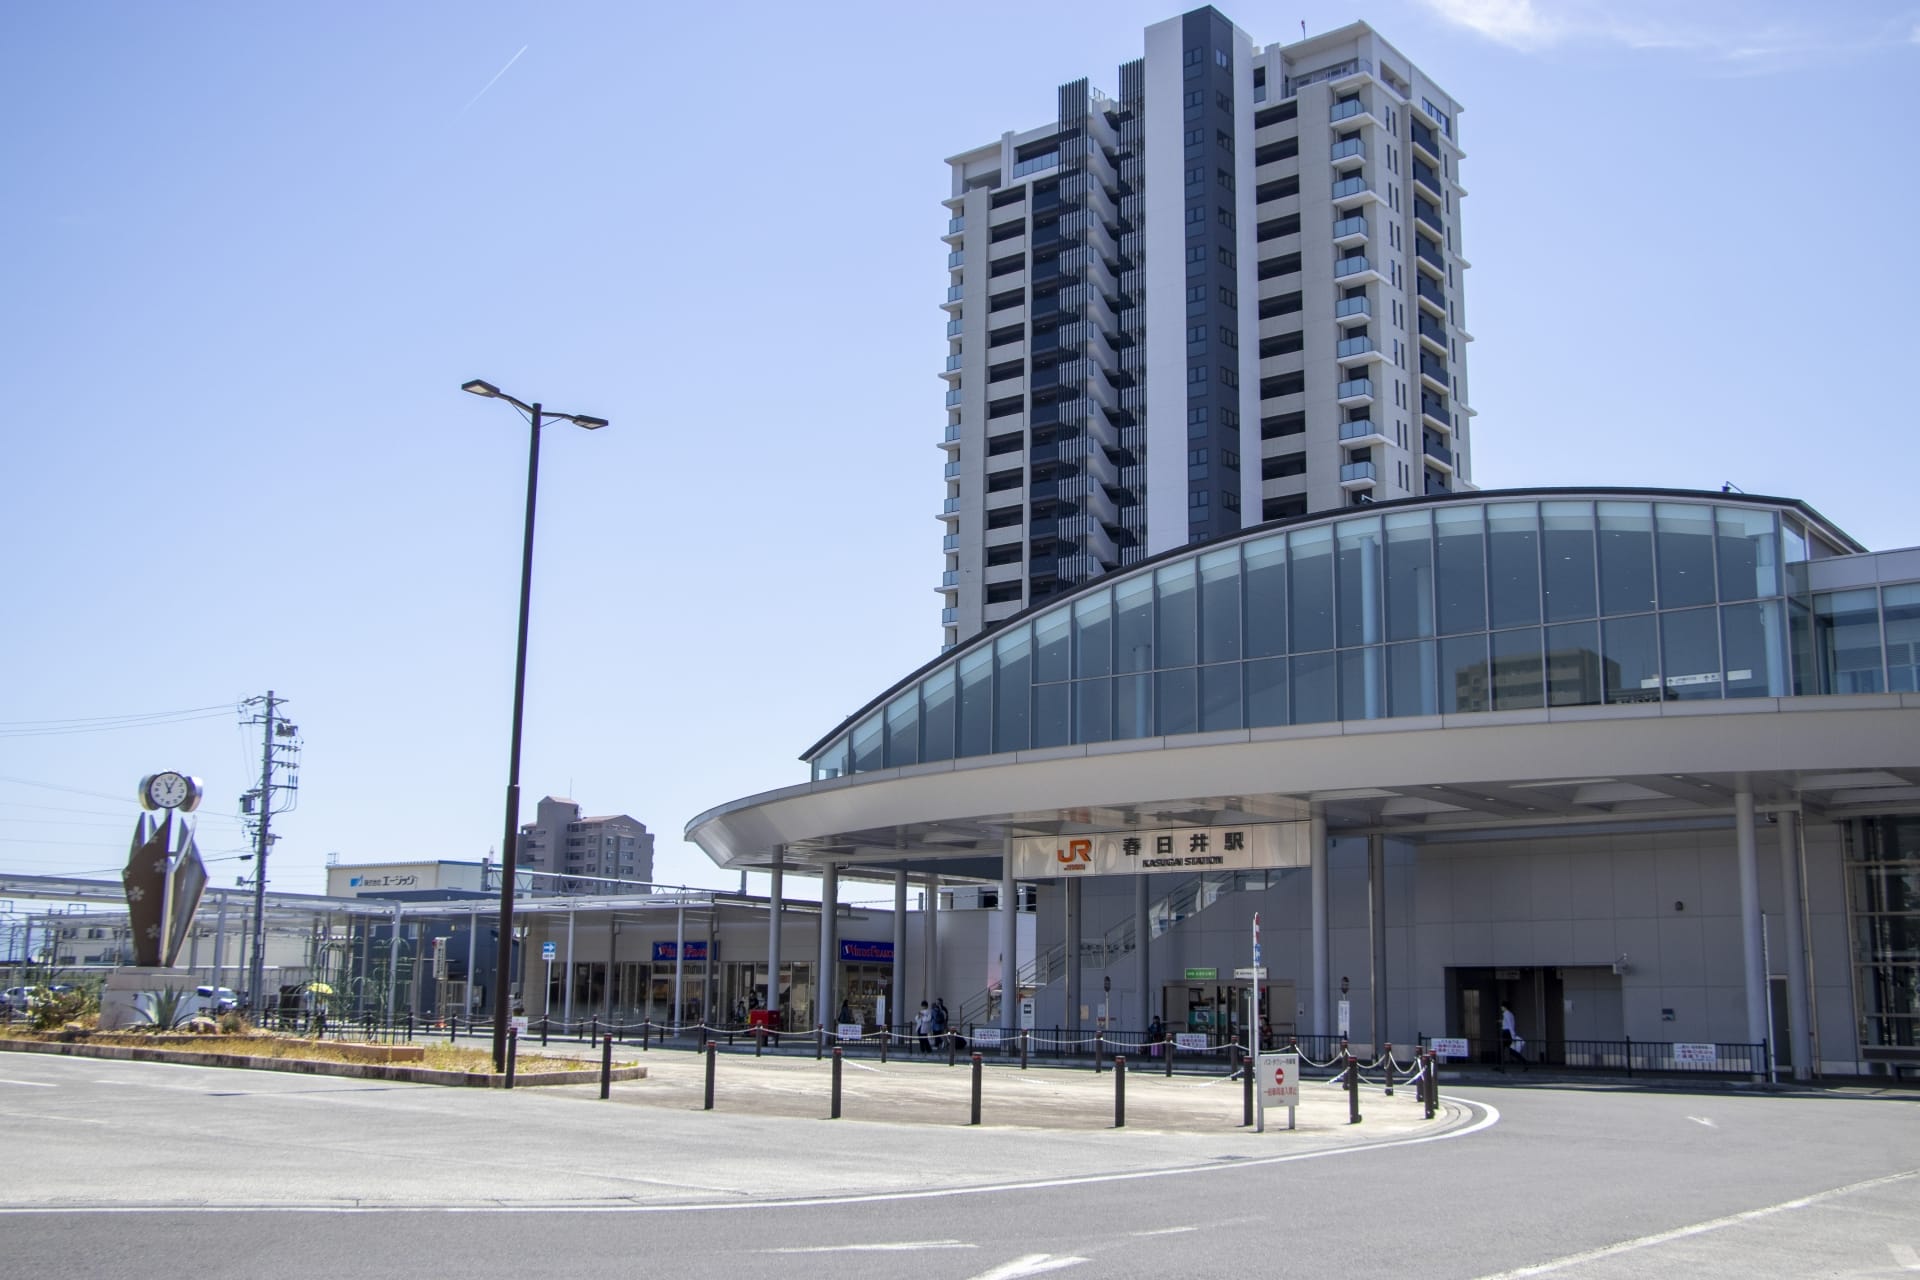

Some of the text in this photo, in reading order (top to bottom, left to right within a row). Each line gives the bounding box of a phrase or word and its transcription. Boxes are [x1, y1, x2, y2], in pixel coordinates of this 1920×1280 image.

[1057, 839, 1092, 862] JR
[1122, 832, 1244, 856] 春日井駅
[1142, 856, 1224, 868] KASUGAI STATION
